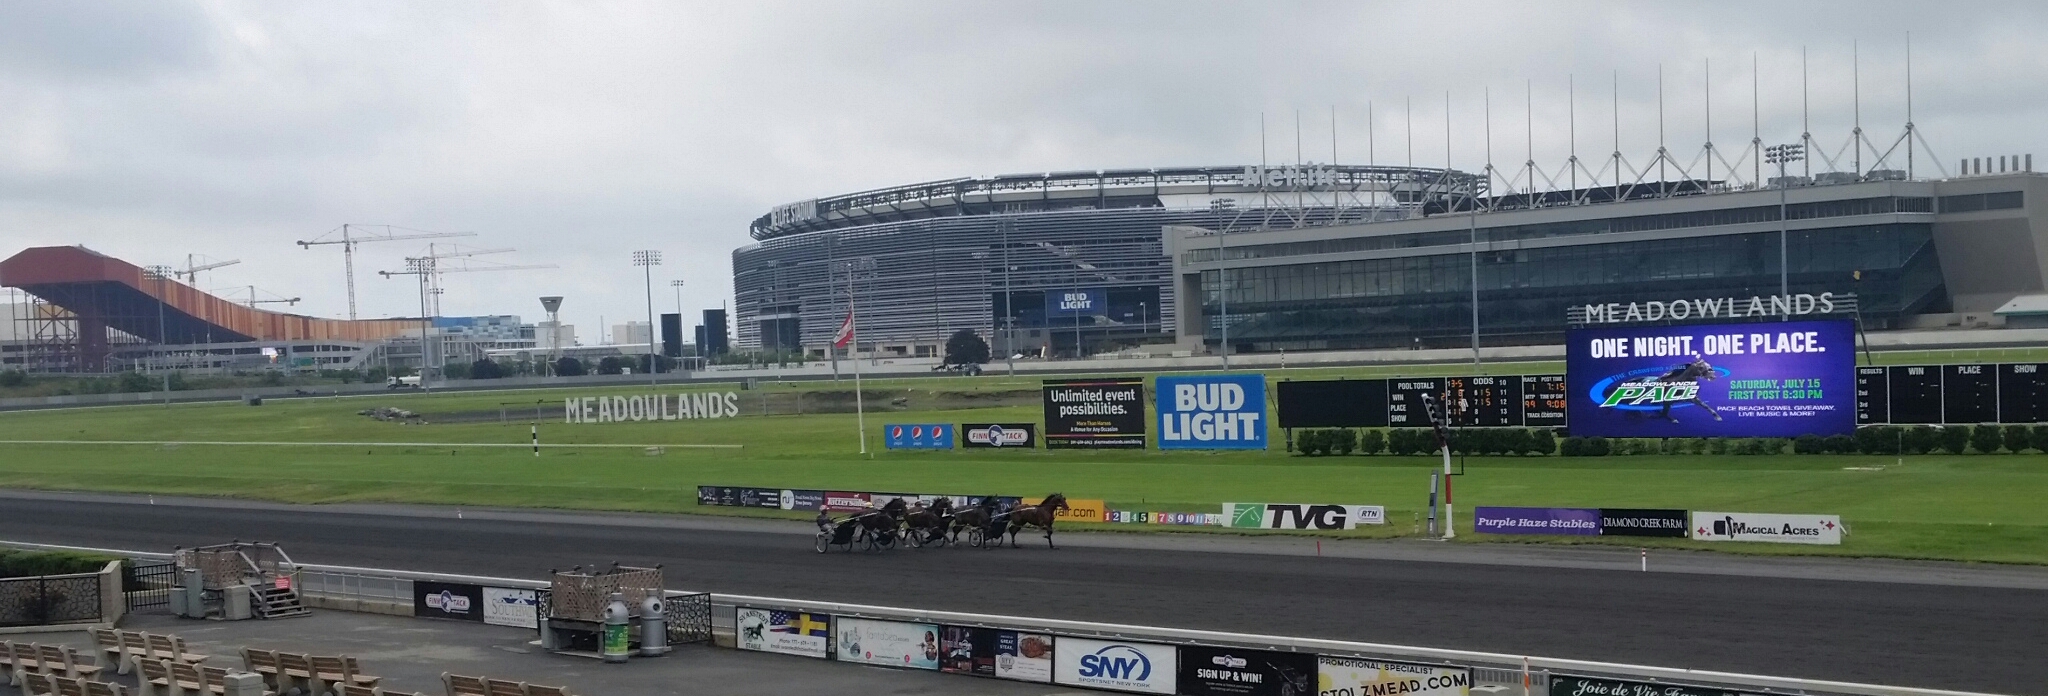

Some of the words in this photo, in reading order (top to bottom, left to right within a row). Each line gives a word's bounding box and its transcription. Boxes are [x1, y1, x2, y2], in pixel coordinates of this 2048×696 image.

[1064, 293, 1087, 301] BUD
[1061, 301, 1091, 309] LIGHT
[1585, 292, 1834, 324] MEADOWLANDS
[1591, 338, 1628, 358] ONE
[1634, 336, 1698, 357] NIGHT.
[1704, 334, 1744, 355] ONE
[1751, 332, 1825, 354] PLACE.
[1908, 367, 1924, 375] WIN
[1958, 366, 1981, 374] PLACE
[2014, 365, 2037, 373] SHOW
[1730, 380, 1780, 390] SATURDAY,
[1782, 379, 1805, 389] JULY
[1807, 379, 1820, 388] 15
[1051, 389, 1103, 403] Unlimited
[1105, 389, 1135, 401] event
[1175, 383, 1244, 411] BUD
[1599, 385, 1699, 407] PACE
[1729, 390, 1754, 400] FIRST
[1757, 390, 1780, 399] POST
[1783, 390, 1805, 399] 6:30
[1807, 390, 1823, 399] PM
[565, 391, 739, 423] MEADOWLANDS
[1060, 402, 1127, 418] possibilities.
[1163, 412, 1259, 441] LIGHT
[1113, 513, 1119, 521] 2
[1131, 513, 1137, 521] 4
[1141, 513, 1147, 521] 5
[1159, 514, 1165, 522] 7
[1178, 514, 1183, 522] 9
[1185, 515, 1195, 523] 10
[1267, 504, 1346, 529] TVG
[1478, 518, 1516, 528] Purple
[1518, 518, 1547, 527] Haze
[1550, 519, 1596, 529] Stables
[1603, 518, 1639, 528] DIAMOND
[1640, 518, 1661, 528] CREEK
[1663, 519, 1683, 528] FARM
[1733, 522, 1778, 535] MAGICAL
[1782, 523, 1819, 535] ACRES
[1079, 654, 1139, 680] SNY
[1320, 658, 1381, 670] PROMOTIONAL
[1385, 663, 1433, 675] SPECIALIST
[1079, 677, 1115, 685] SPORTSNET
[1197, 668, 1218, 680] SIGN
[1220, 670, 1231, 680] UP
[1233, 672, 1239, 681] &
[1241, 672, 1262, 683] WIN!
[1573, 679, 1608, 695] Joie
[1611, 682, 1629, 696] de
[1633, 684, 1659, 696] Vie
